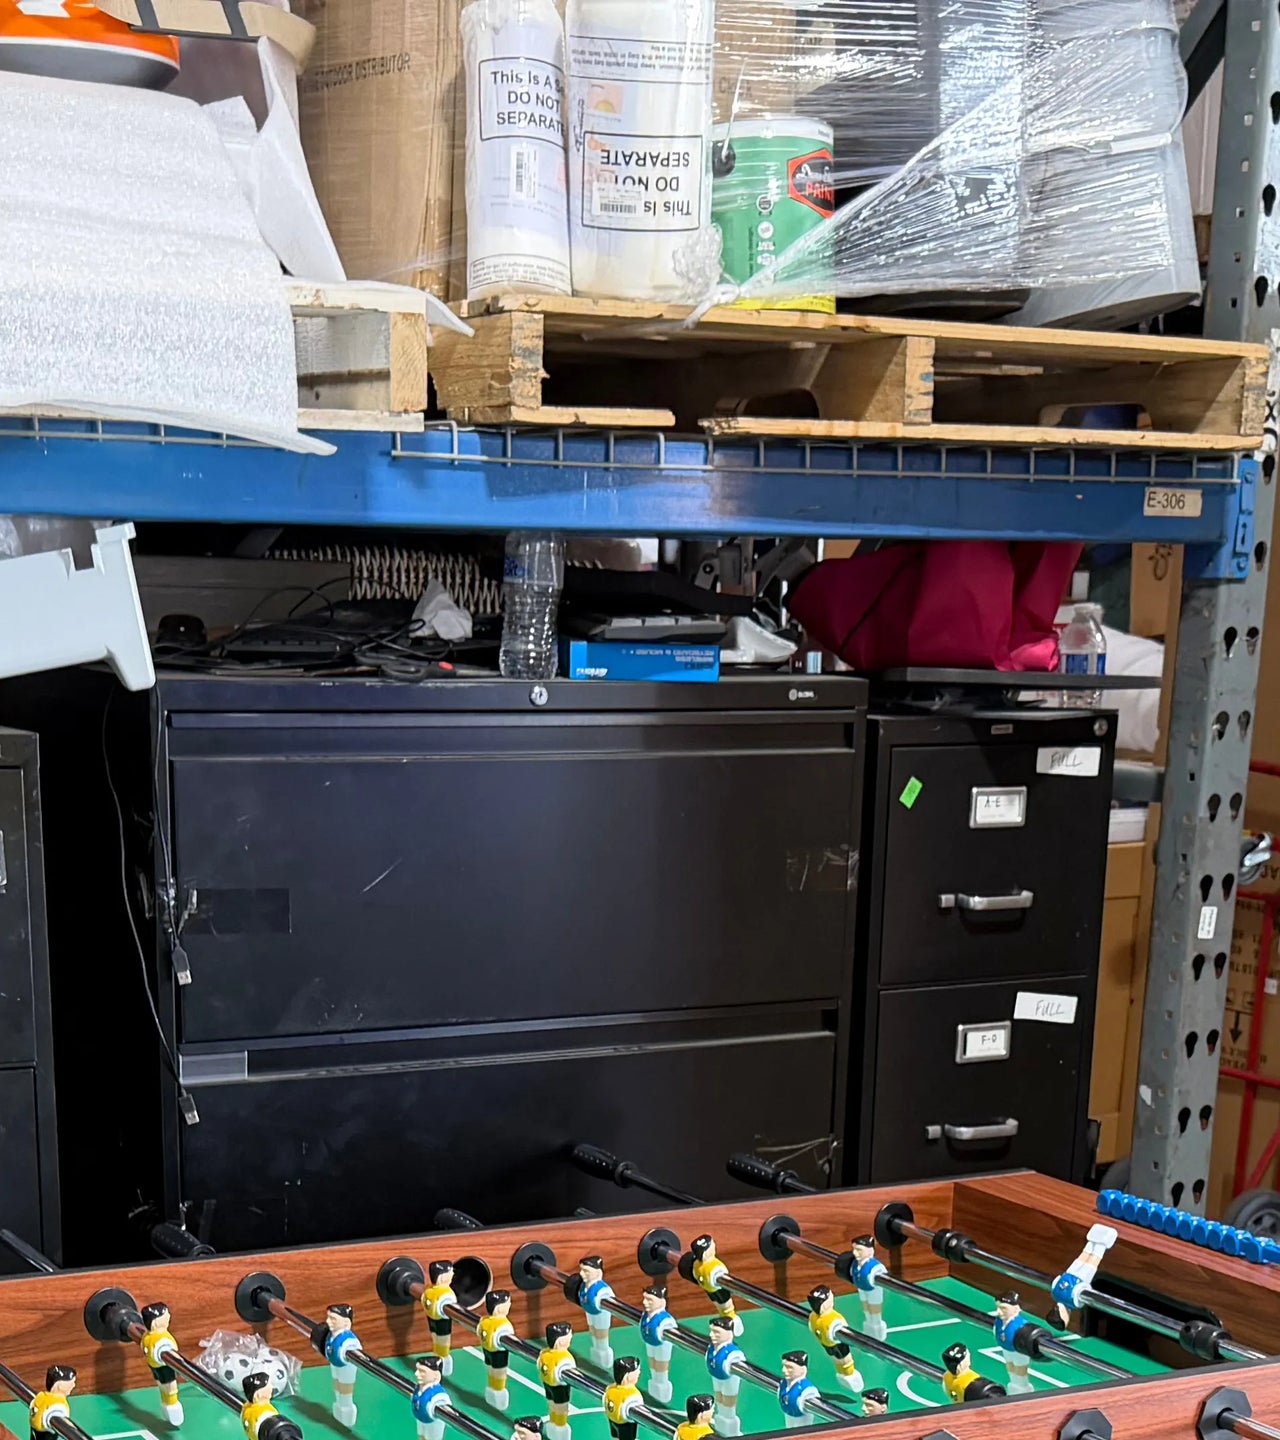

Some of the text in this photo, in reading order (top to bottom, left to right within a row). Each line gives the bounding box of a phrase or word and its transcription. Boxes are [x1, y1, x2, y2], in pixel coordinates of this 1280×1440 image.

[490, 70, 523, 86] This
[528, 70, 540, 86] Is
[543, 72, 553, 88] A
[507, 90, 561, 112] DO NOT
[600, 149, 690, 168] SEPARATE
[655, 176, 679, 192] DO
[644, 200, 692, 217] This Is
[1146, 491, 1185, 510] E-306
[1035, 999, 1065, 1017] FULL
